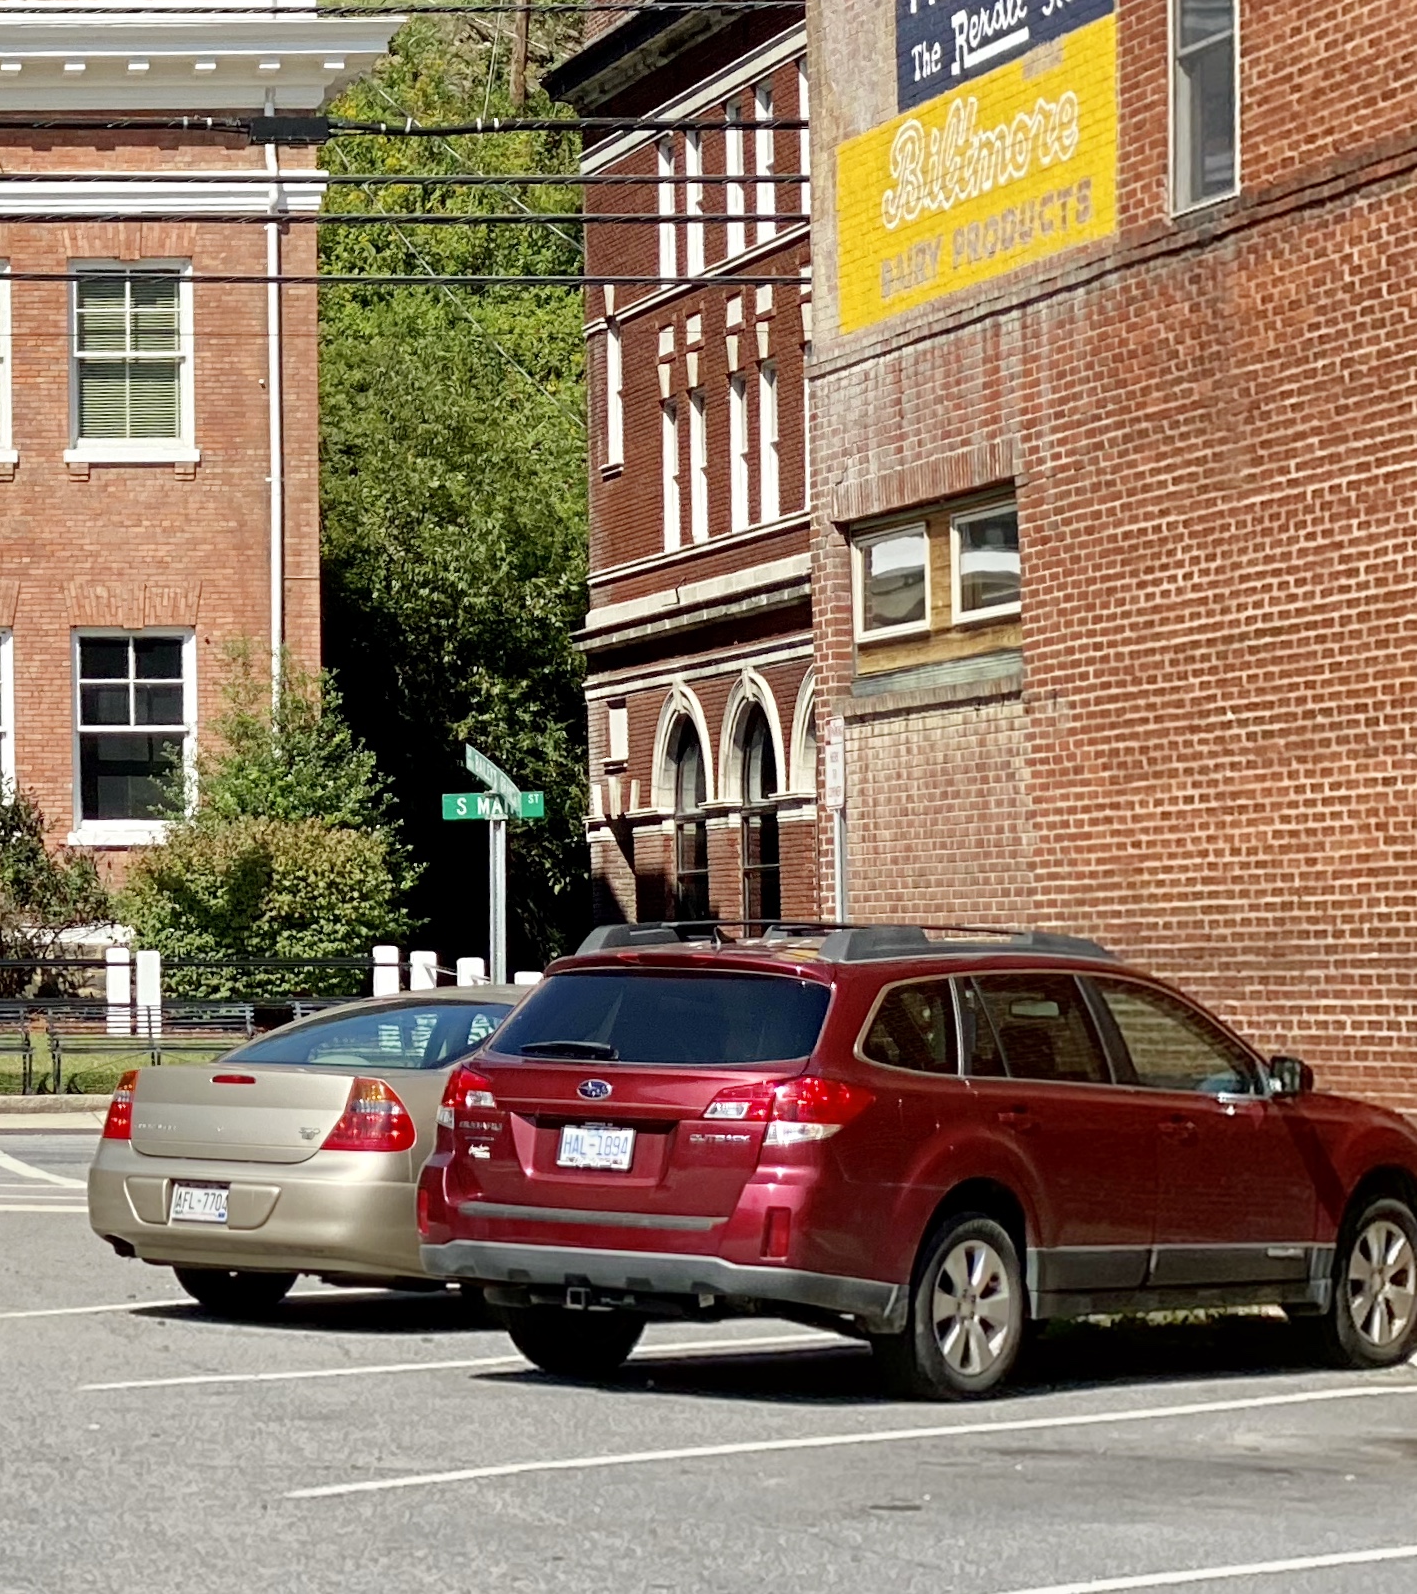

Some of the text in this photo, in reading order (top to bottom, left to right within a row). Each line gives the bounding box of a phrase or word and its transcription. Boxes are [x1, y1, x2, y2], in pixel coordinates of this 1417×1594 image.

[911, 40, 942, 82] The
[881, 90, 1080, 230] Biltmore
[952, 176, 1093, 271] PRODUCTS
[456, 797, 467, 816] S
[527, 793, 539, 804] ST
[563, 1134, 629, 1157] HAL-1894
